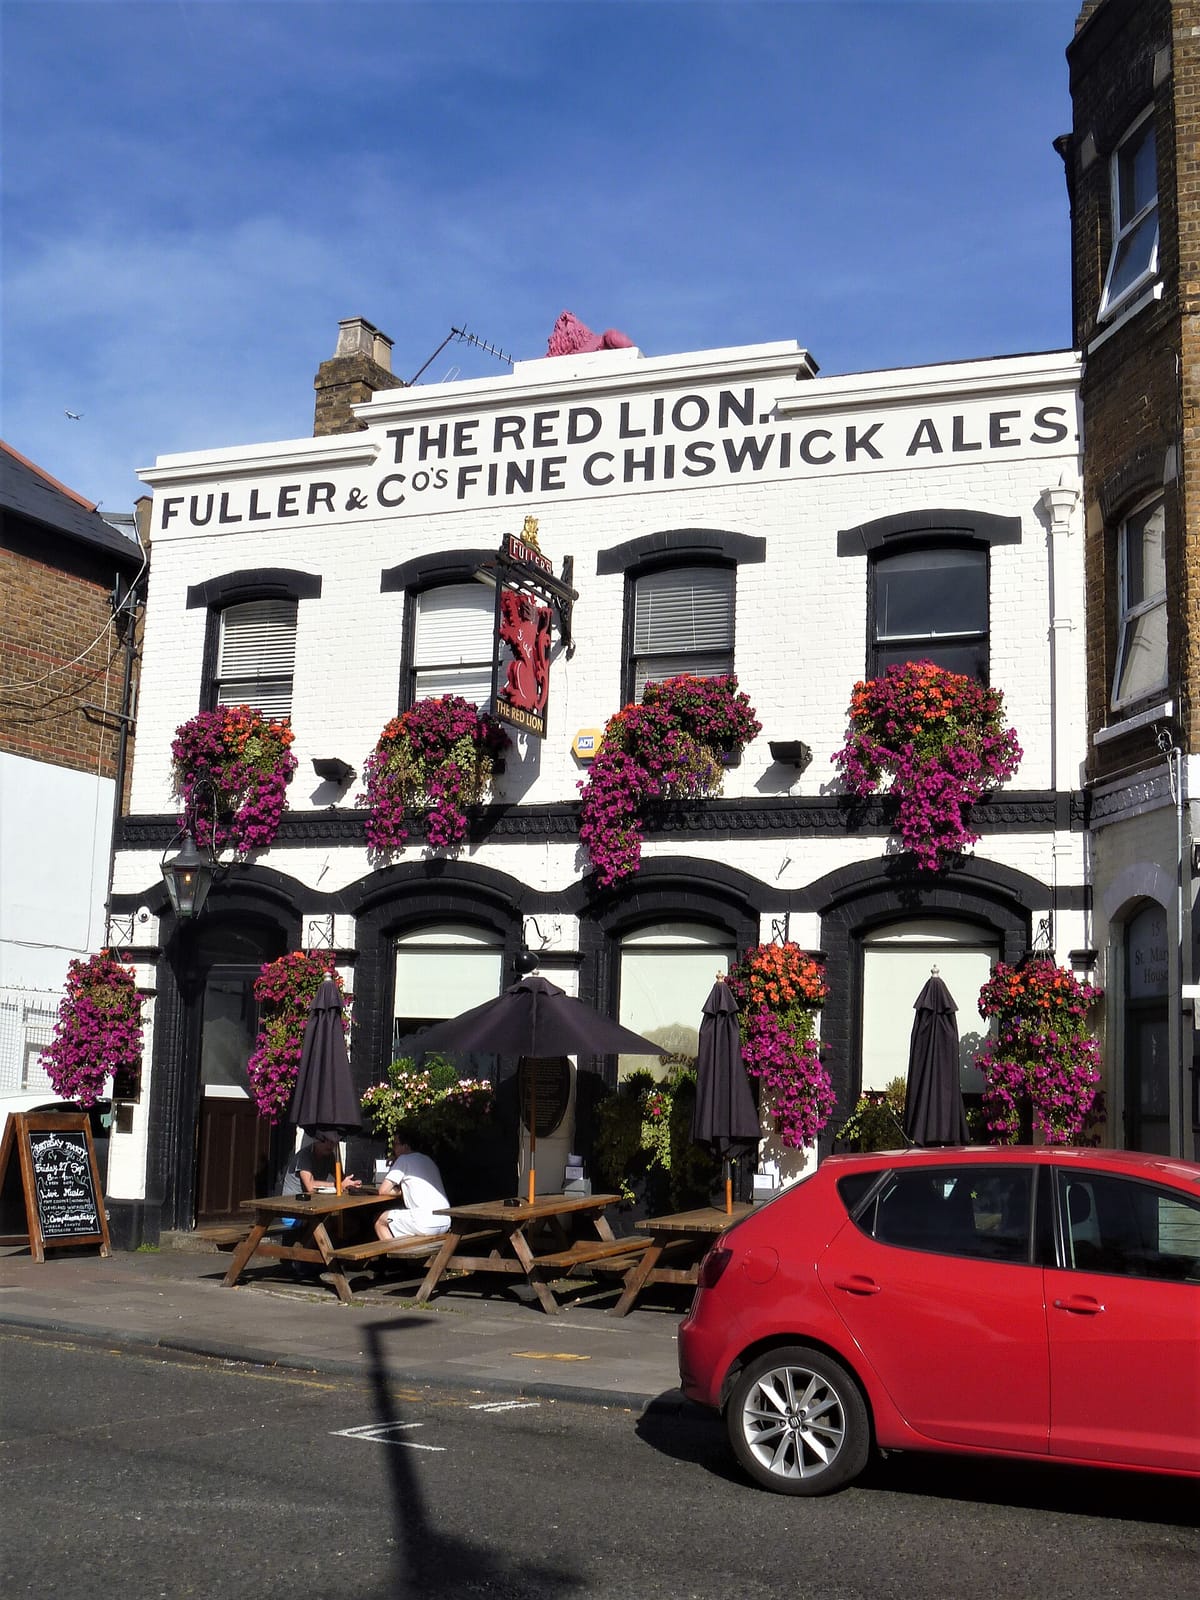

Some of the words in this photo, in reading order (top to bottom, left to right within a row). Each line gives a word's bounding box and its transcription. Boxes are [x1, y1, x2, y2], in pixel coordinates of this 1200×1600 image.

[386, 419, 480, 464] THE
[493, 406, 603, 453] RED
[161, 481, 336, 530] FULLER
[344, 487, 369, 512] &
[456, 455, 568, 500] FINE
[582, 422, 885, 486] CHISWICK
[496, 699, 510, 716] THE
[511, 709, 525, 723] RED
[526, 715, 544, 732] LION
[578, 738, 594, 749] ADT
